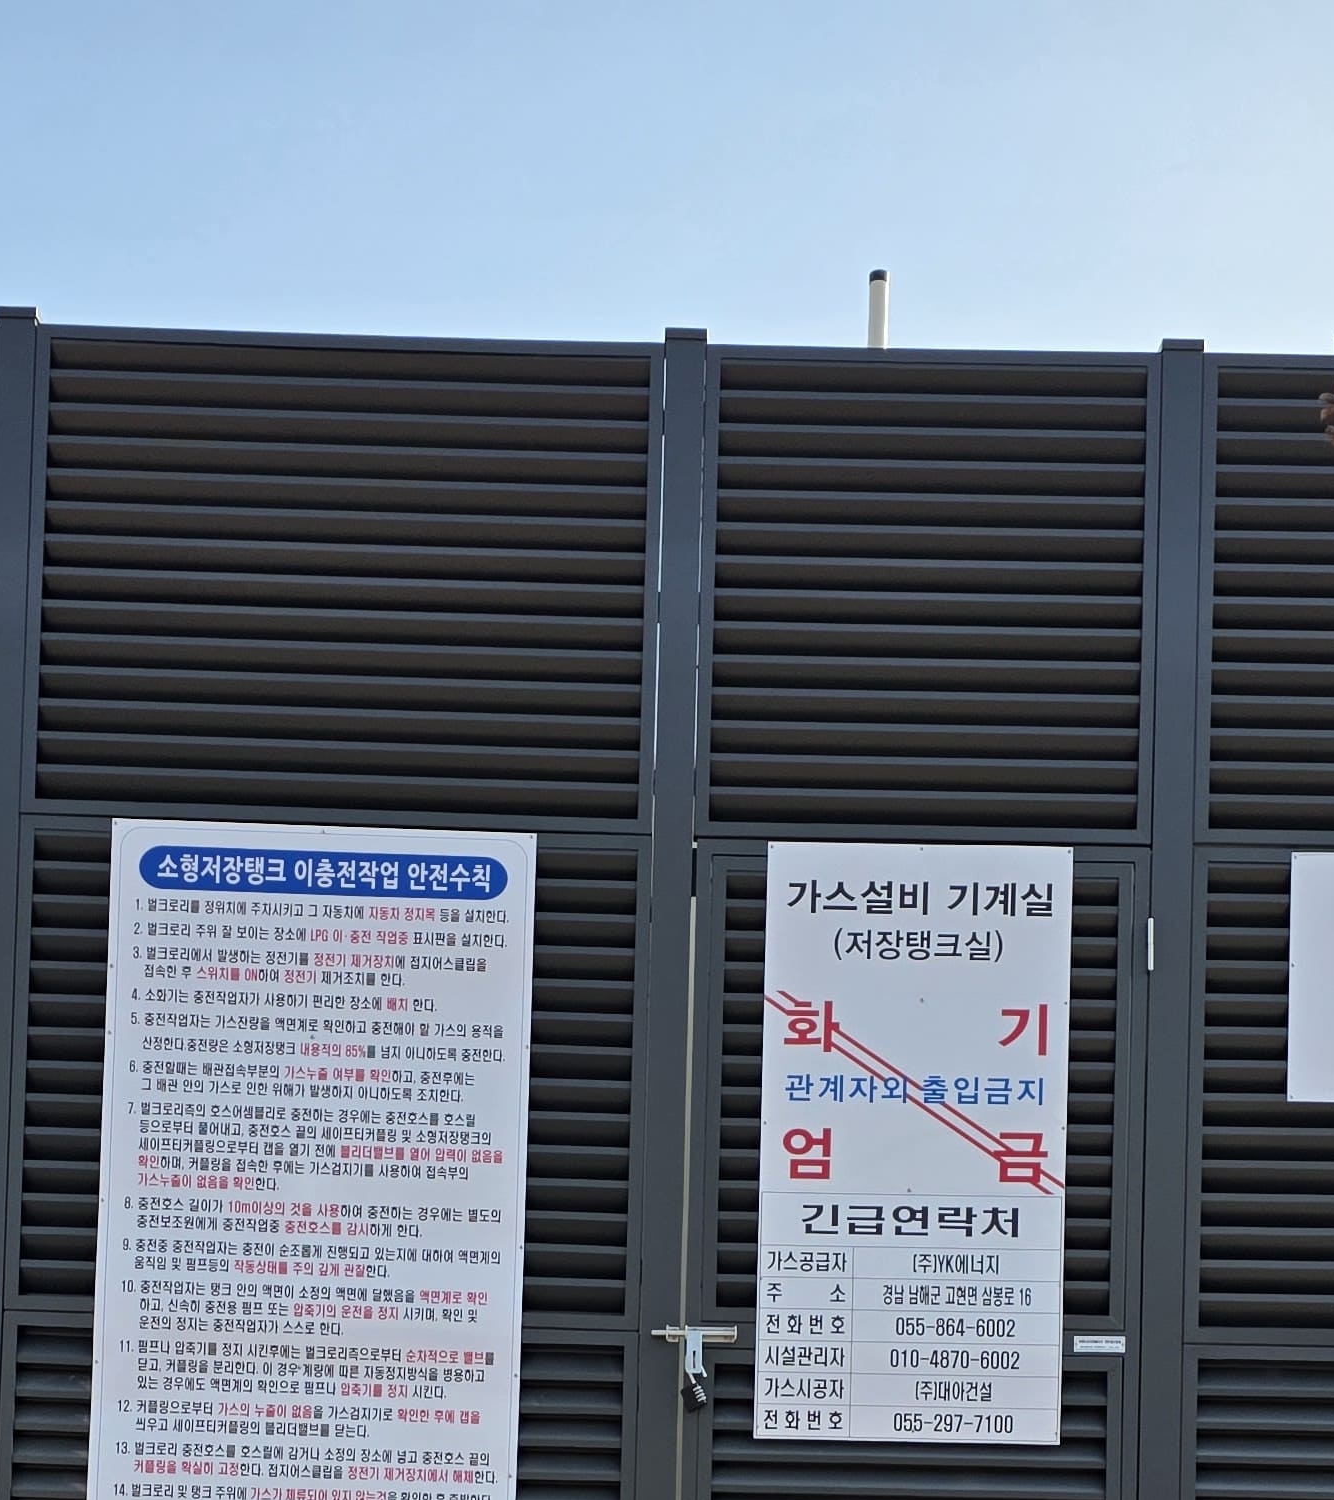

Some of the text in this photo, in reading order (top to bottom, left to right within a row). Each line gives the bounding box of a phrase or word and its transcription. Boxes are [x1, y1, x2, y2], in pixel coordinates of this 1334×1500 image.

[158, 854, 490, 892] 소형저장탱크 이충전작업 안전수칙
[787, 880, 1052, 917] 가스설비 기계실
[135, 898, 460, 923] 1. 그 자동차 정지목 등을
[133, 921, 408, 946] 2. 주위 잘 보이는 장소에 LPG 작업중
[132, 945, 346, 967] 3. 발생하는 정전기
[835, 928, 1002, 962] (저장탱크실)
[181, 965, 405, 987] 후 ON하여 정전기 한다.
[131, 987, 437, 1013] 4. 소화기는 사용하기 장소에 한다.
[130, 1011, 504, 1039] 5. 가스의 용적을
[300, 1042, 401, 1060] 내용적의 넘지
[129, 1059, 139, 1073] 6.
[141, 1077, 353, 1099] 그 안의 가스로 인한 발생하지
[785, 1074, 1044, 1105] 관계자외 출입금지
[127, 1101, 381, 1125] 7. 경우에는
[401, 1129, 412, 1144] 및
[314, 1143, 336, 1158] 전에
[378, 1164, 469, 1181] 사용하여 접속부의
[124, 1195, 463, 1222] 8. 길이가 10m이상의 것을 사용하여 경우에는
[397, 1224, 423, 1238] 한다.
[802, 1205, 1018, 1237] 긴급연락처
[122, 1237, 454, 1264] 9. 있는지에 대하여
[134, 1255, 314, 1276] 움직임 및 주의
[768, 1251, 999, 1274] 가스공급자 (주)YK에너지
[121, 1279, 368, 1302] 10. 안의 액면이 소정의 액면에
[883, 1285, 904, 1305] 경남
[909, 1285, 940, 1305] 남해군
[945, 1286, 977, 1305] 고현면
[982, 1287, 1014, 1307] 삼봉로
[1020, 1288, 1031, 1306] 16
[267, 1302, 478, 1324] 또는 운전을 정지 및
[139, 1315, 344, 1337] 운전의 정지는 스스로 한다.
[896, 1317, 1015, 1337] 055-864-6002
[119, 1339, 243, 1357] 11. 정지
[765, 1346, 1019, 1369] 시설관리자 010-4870-6002
[262, 1361, 297, 1377] 이 경우
[137, 1375, 447, 1400] 있는 정지 시킨다.
[765, 1378, 991, 1401] 가스시공자 (주)대아건설
[117, 1399, 250, 1417] 12. 가스의
[894, 1413, 1013, 1433] 055-297-7100
[115, 1441, 393, 1464] 13. 소정의 장소에
[348, 1465, 379, 1481] 정전기
[113, 1483, 128, 1497] 14.
[177, 1484, 188, 1499] 및
[215, 1485, 247, 1500] 주위에
